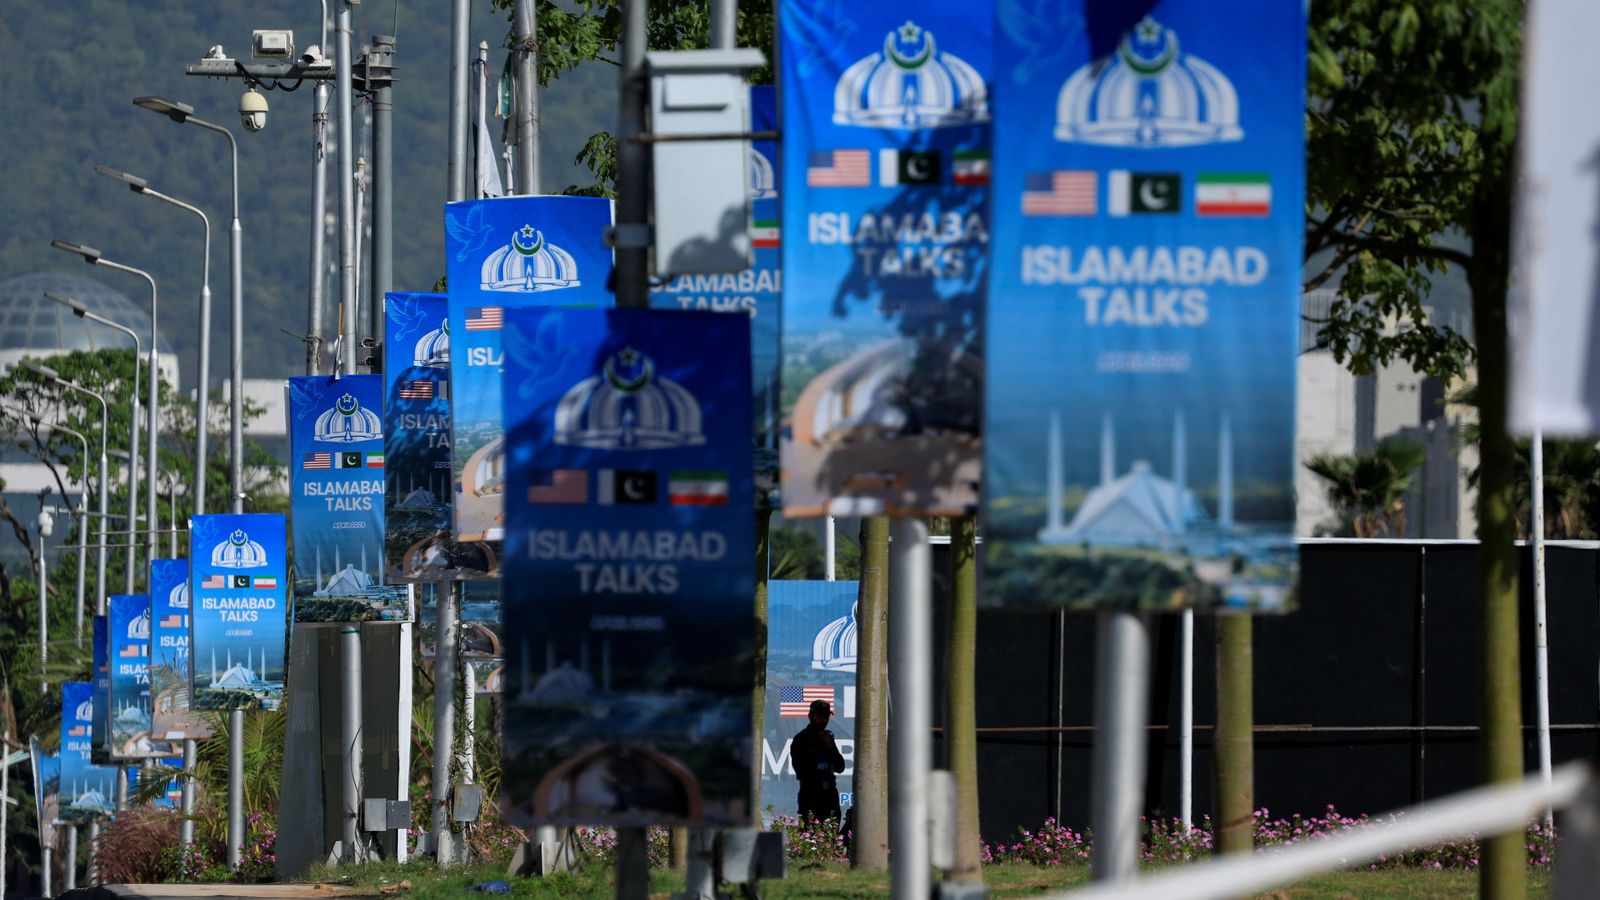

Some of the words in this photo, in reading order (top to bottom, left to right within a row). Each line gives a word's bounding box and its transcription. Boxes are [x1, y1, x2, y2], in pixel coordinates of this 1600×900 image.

[856, 247, 965, 277] TALKS
[1021, 246, 1269, 286] ISLAMABAD
[1080, 288, 1209, 326] TALKS
[325, 497, 372, 511] TALKS
[528, 530, 727, 561] ISLAMABAD
[575, 563, 680, 593] TALKS
[202, 597, 276, 609] ISLAMABAD
[219, 610, 258, 622] TALKS
